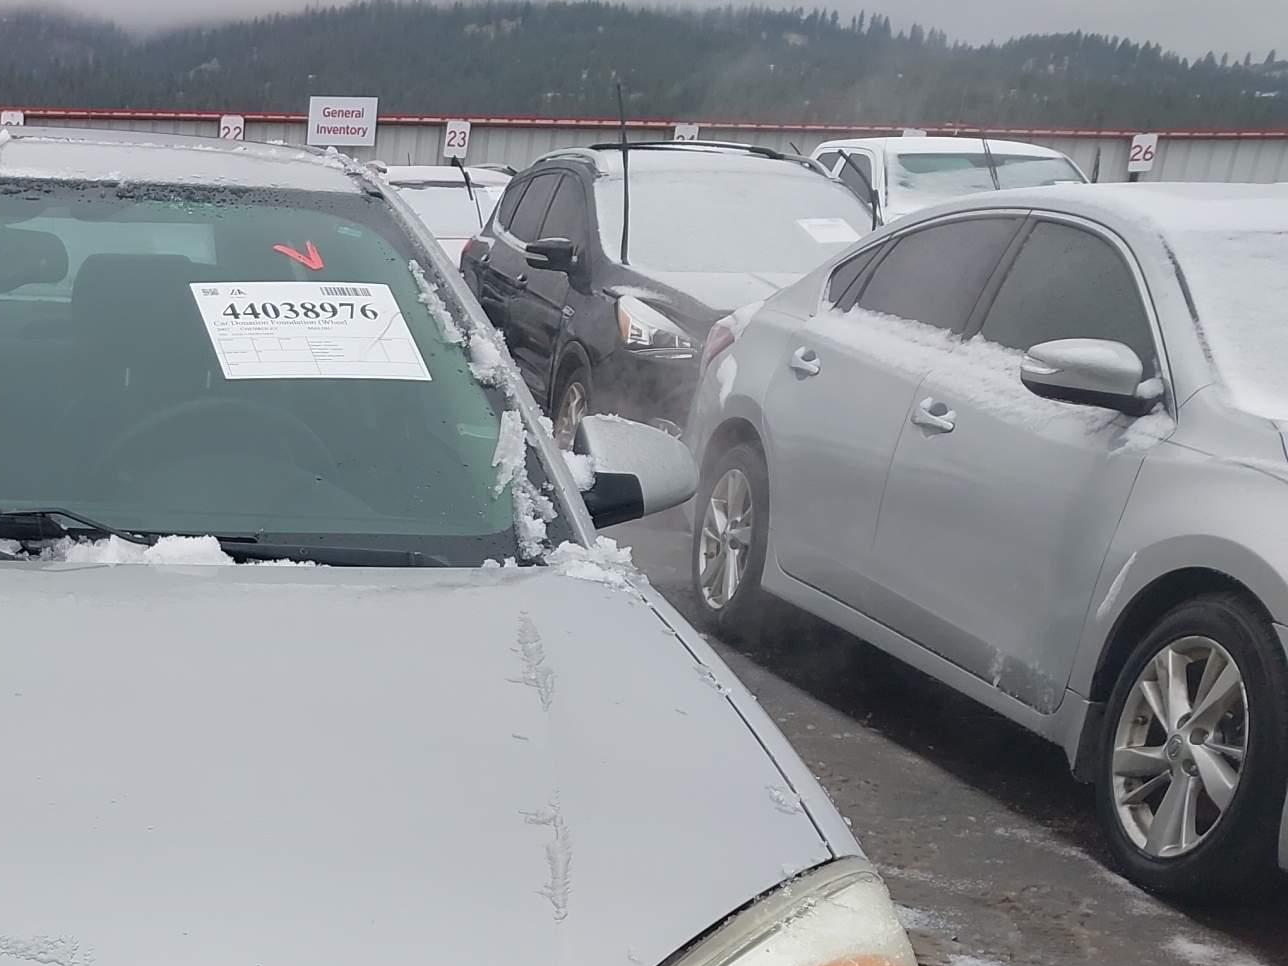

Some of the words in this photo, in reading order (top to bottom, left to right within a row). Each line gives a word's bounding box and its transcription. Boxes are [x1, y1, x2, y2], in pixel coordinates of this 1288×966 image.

[322, 107, 365, 119] General
[222, 126, 242, 140] 22
[316, 124, 368, 138] Inventory
[447, 130, 467, 147] 23
[1130, 144, 1154, 162] 26
[223, 302, 379, 320] 44038976
[271, 319, 316, 327] Foundation
